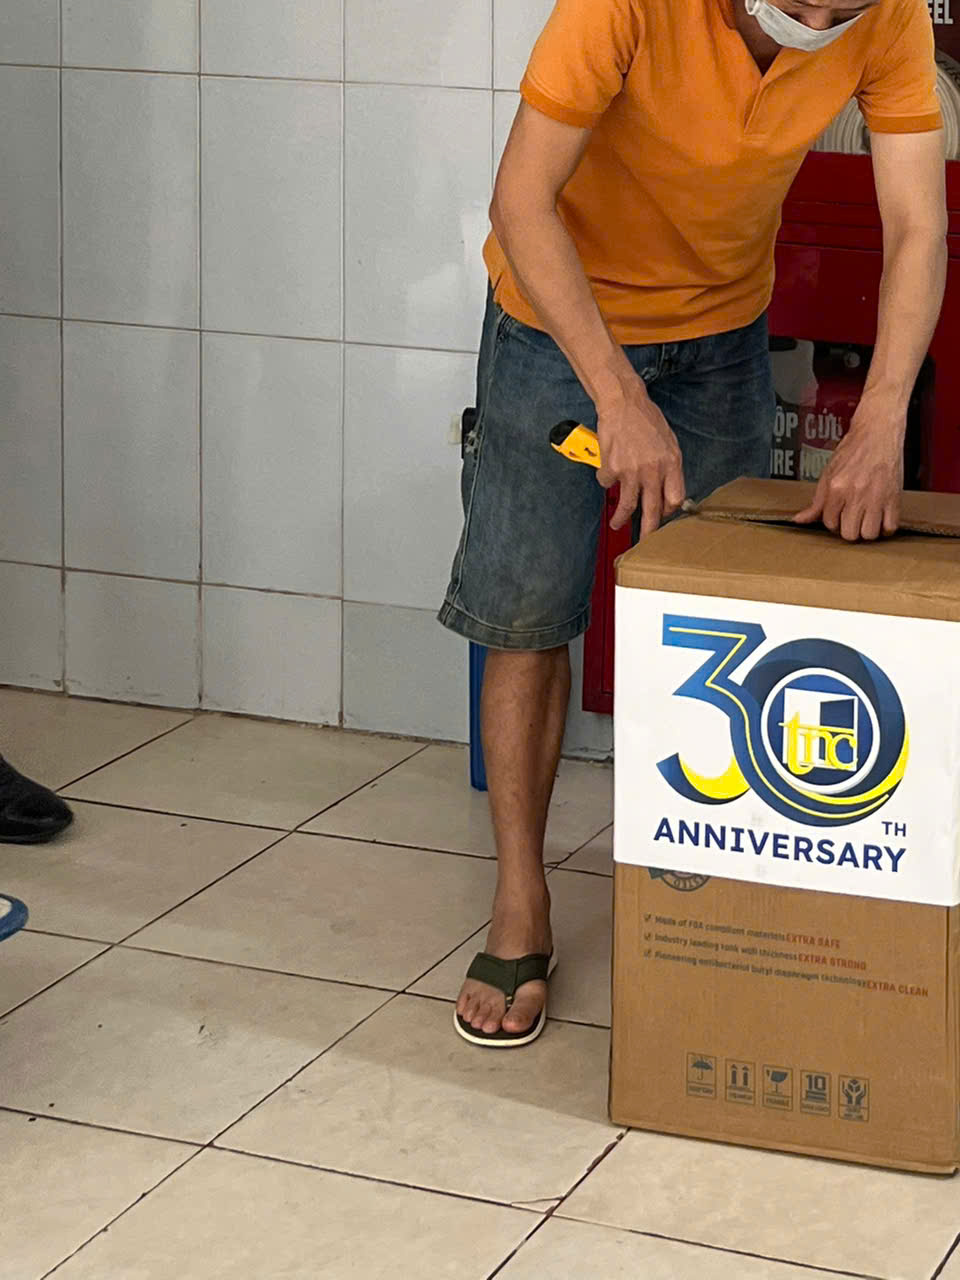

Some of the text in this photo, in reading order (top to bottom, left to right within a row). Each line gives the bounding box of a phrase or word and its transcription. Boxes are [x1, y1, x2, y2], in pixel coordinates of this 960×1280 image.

[656, 613, 911, 828] 30
[881, 821, 907, 837] TH
[653, 817, 907, 873] ANNIVERSARY
[786, 933, 815, 946] EXTRA
[818, 936, 840, 949] SAFE
[798, 953, 827, 965] EXTRA
[830, 957, 866, 970] STRONG
[867, 980, 896, 992] EXTRA
[898, 984, 928, 997] CLEAN
[806, 1074, 826, 1091] 10
